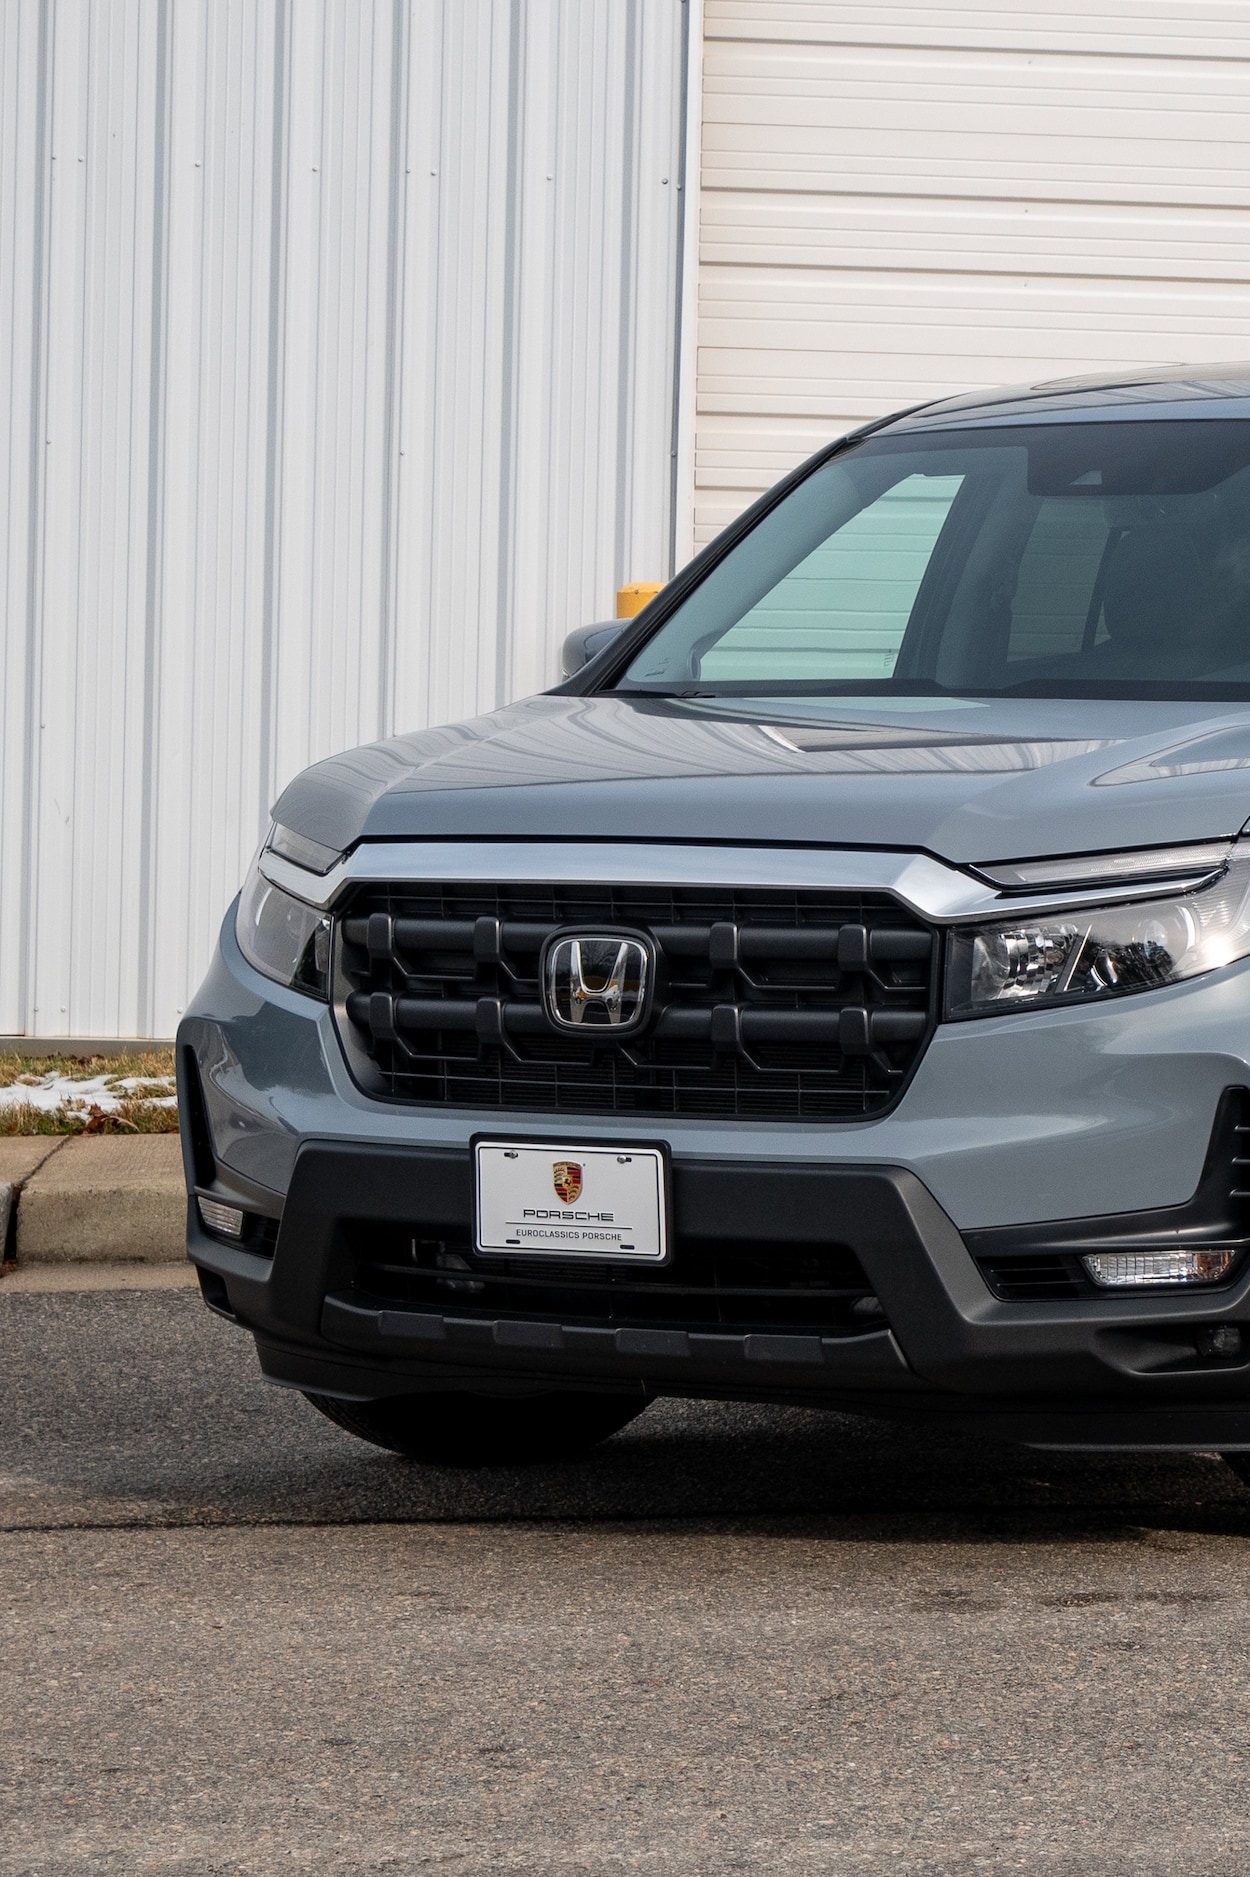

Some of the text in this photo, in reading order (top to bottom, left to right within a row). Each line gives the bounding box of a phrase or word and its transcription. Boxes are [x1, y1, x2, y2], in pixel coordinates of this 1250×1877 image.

[523, 1209, 614, 1222] PORSCHE
[516, 1228, 622, 1241] EUROCLASSICS PORSCHE
